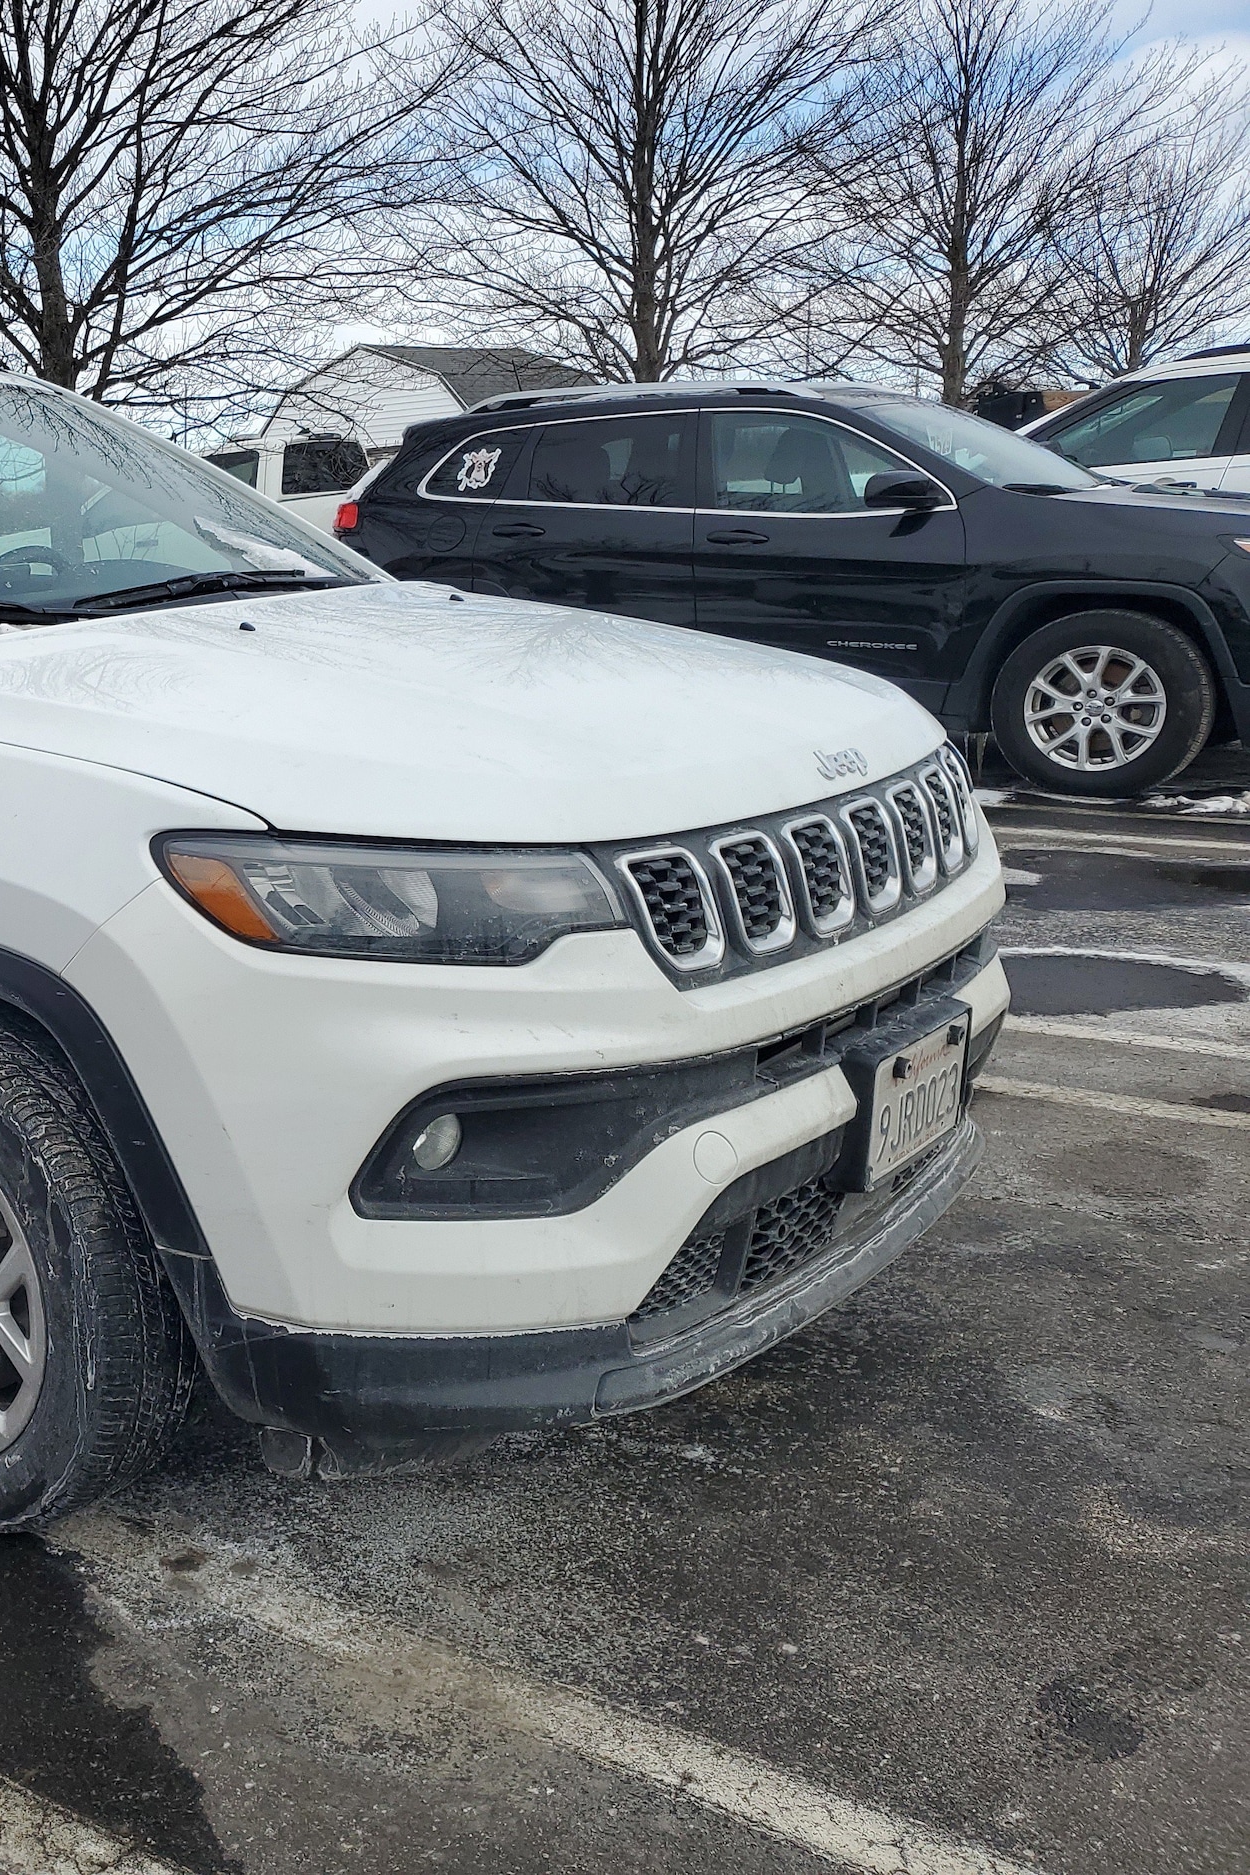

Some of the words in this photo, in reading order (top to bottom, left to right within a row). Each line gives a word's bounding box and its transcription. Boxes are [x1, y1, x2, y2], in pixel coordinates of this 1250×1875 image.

[826, 640, 918, 651] CHEROKEE
[812, 747, 869, 781] Jeep
[892, 1042, 951, 1088] lifornia
[876, 1060, 959, 1163] 9JRD023
